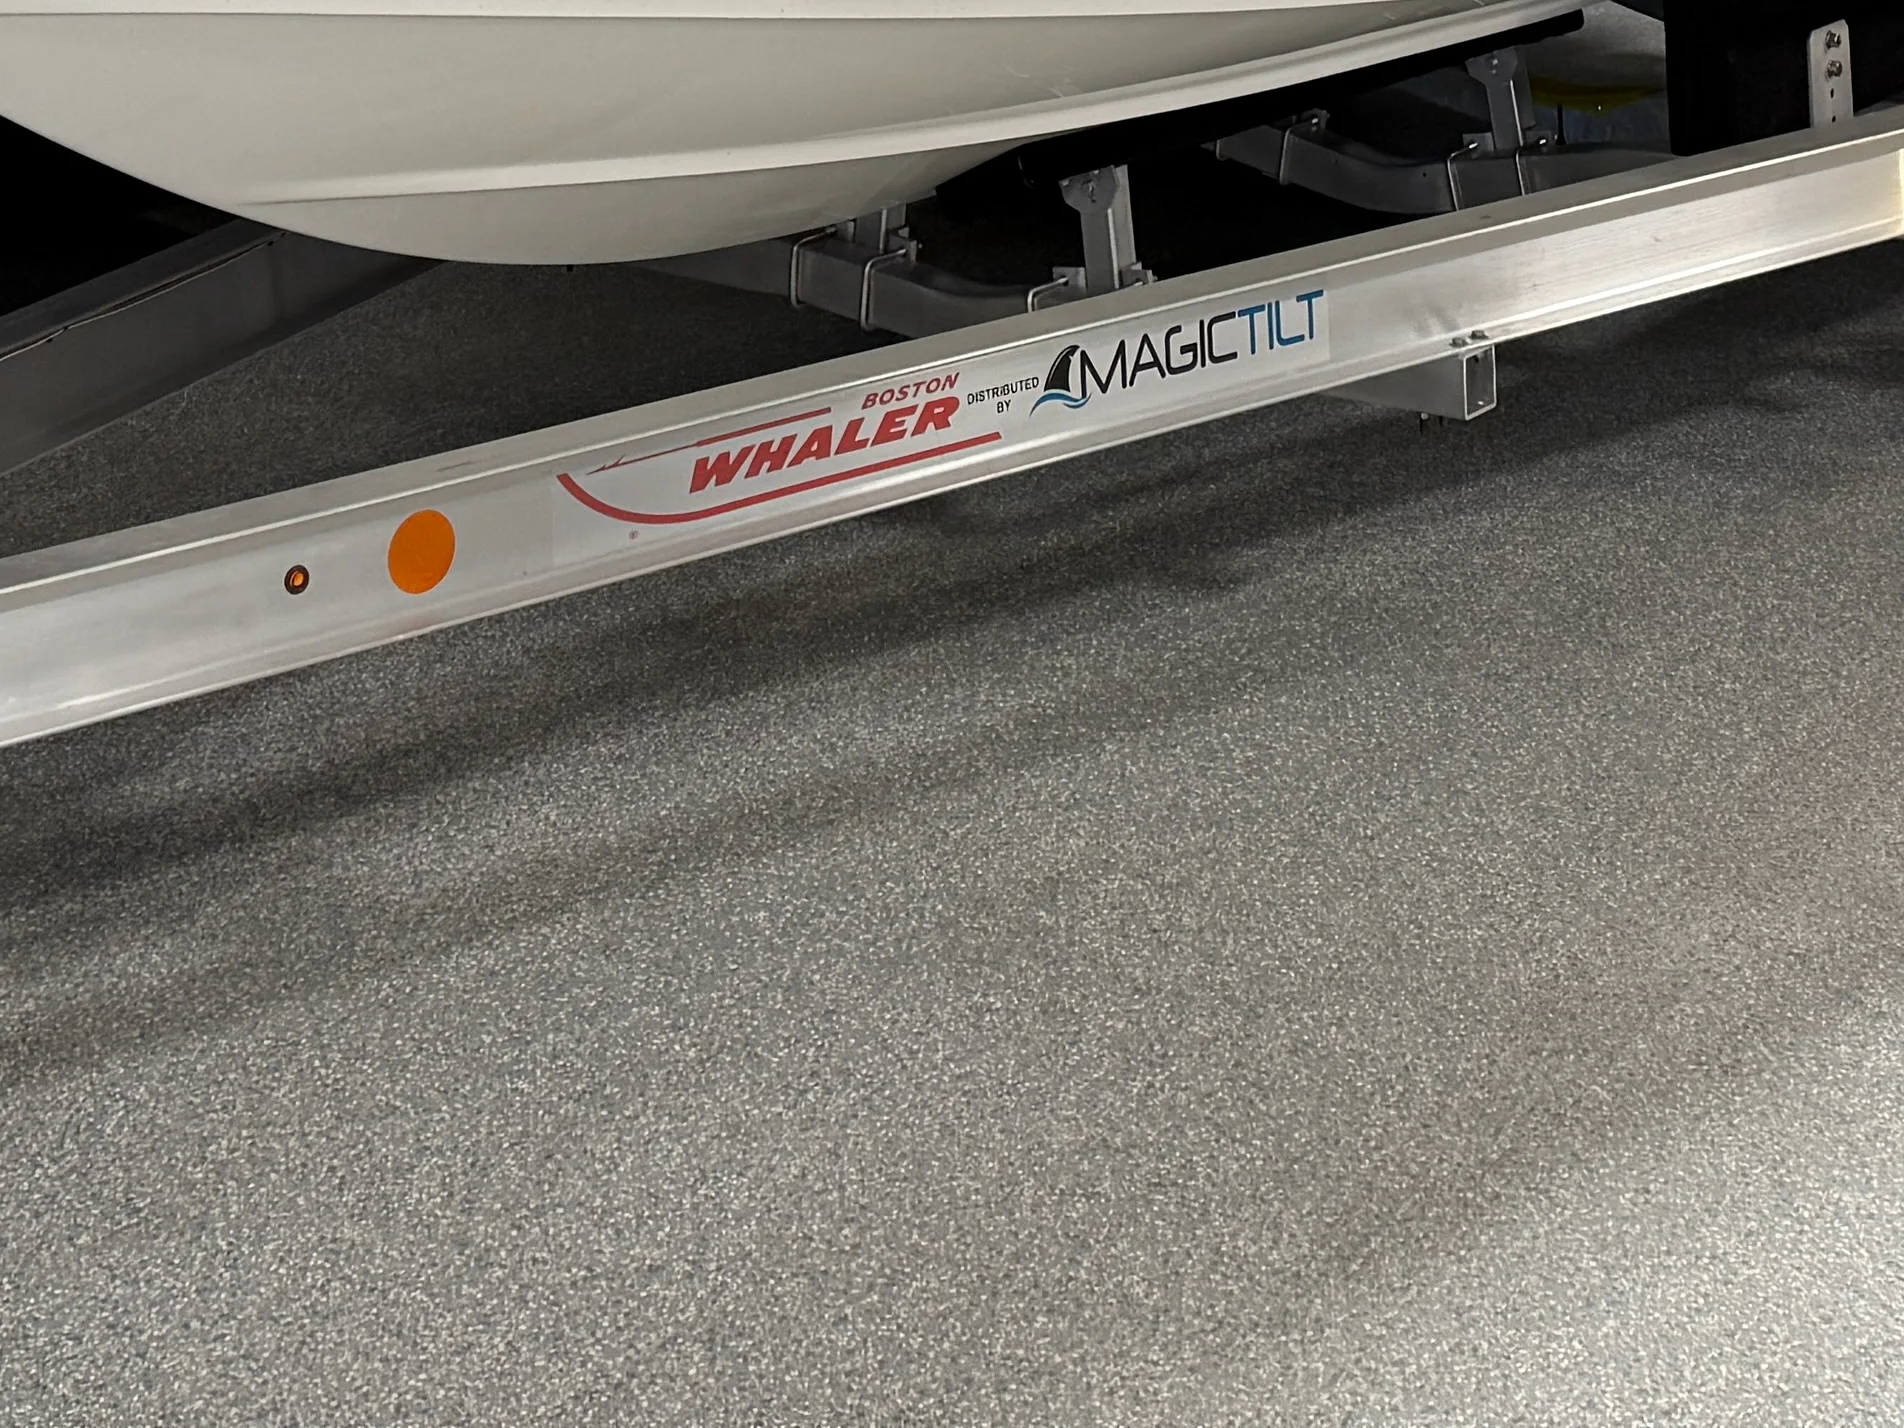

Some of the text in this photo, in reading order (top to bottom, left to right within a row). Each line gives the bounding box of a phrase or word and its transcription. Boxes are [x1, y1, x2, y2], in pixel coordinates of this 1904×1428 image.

[1079, 288, 1325, 399] MAGICTILT
[861, 371, 961, 411] BOSTON
[967, 376, 1040, 406] DISTRIBUTED
[996, 399, 1012, 414] BY
[689, 395, 961, 494] WHALER
